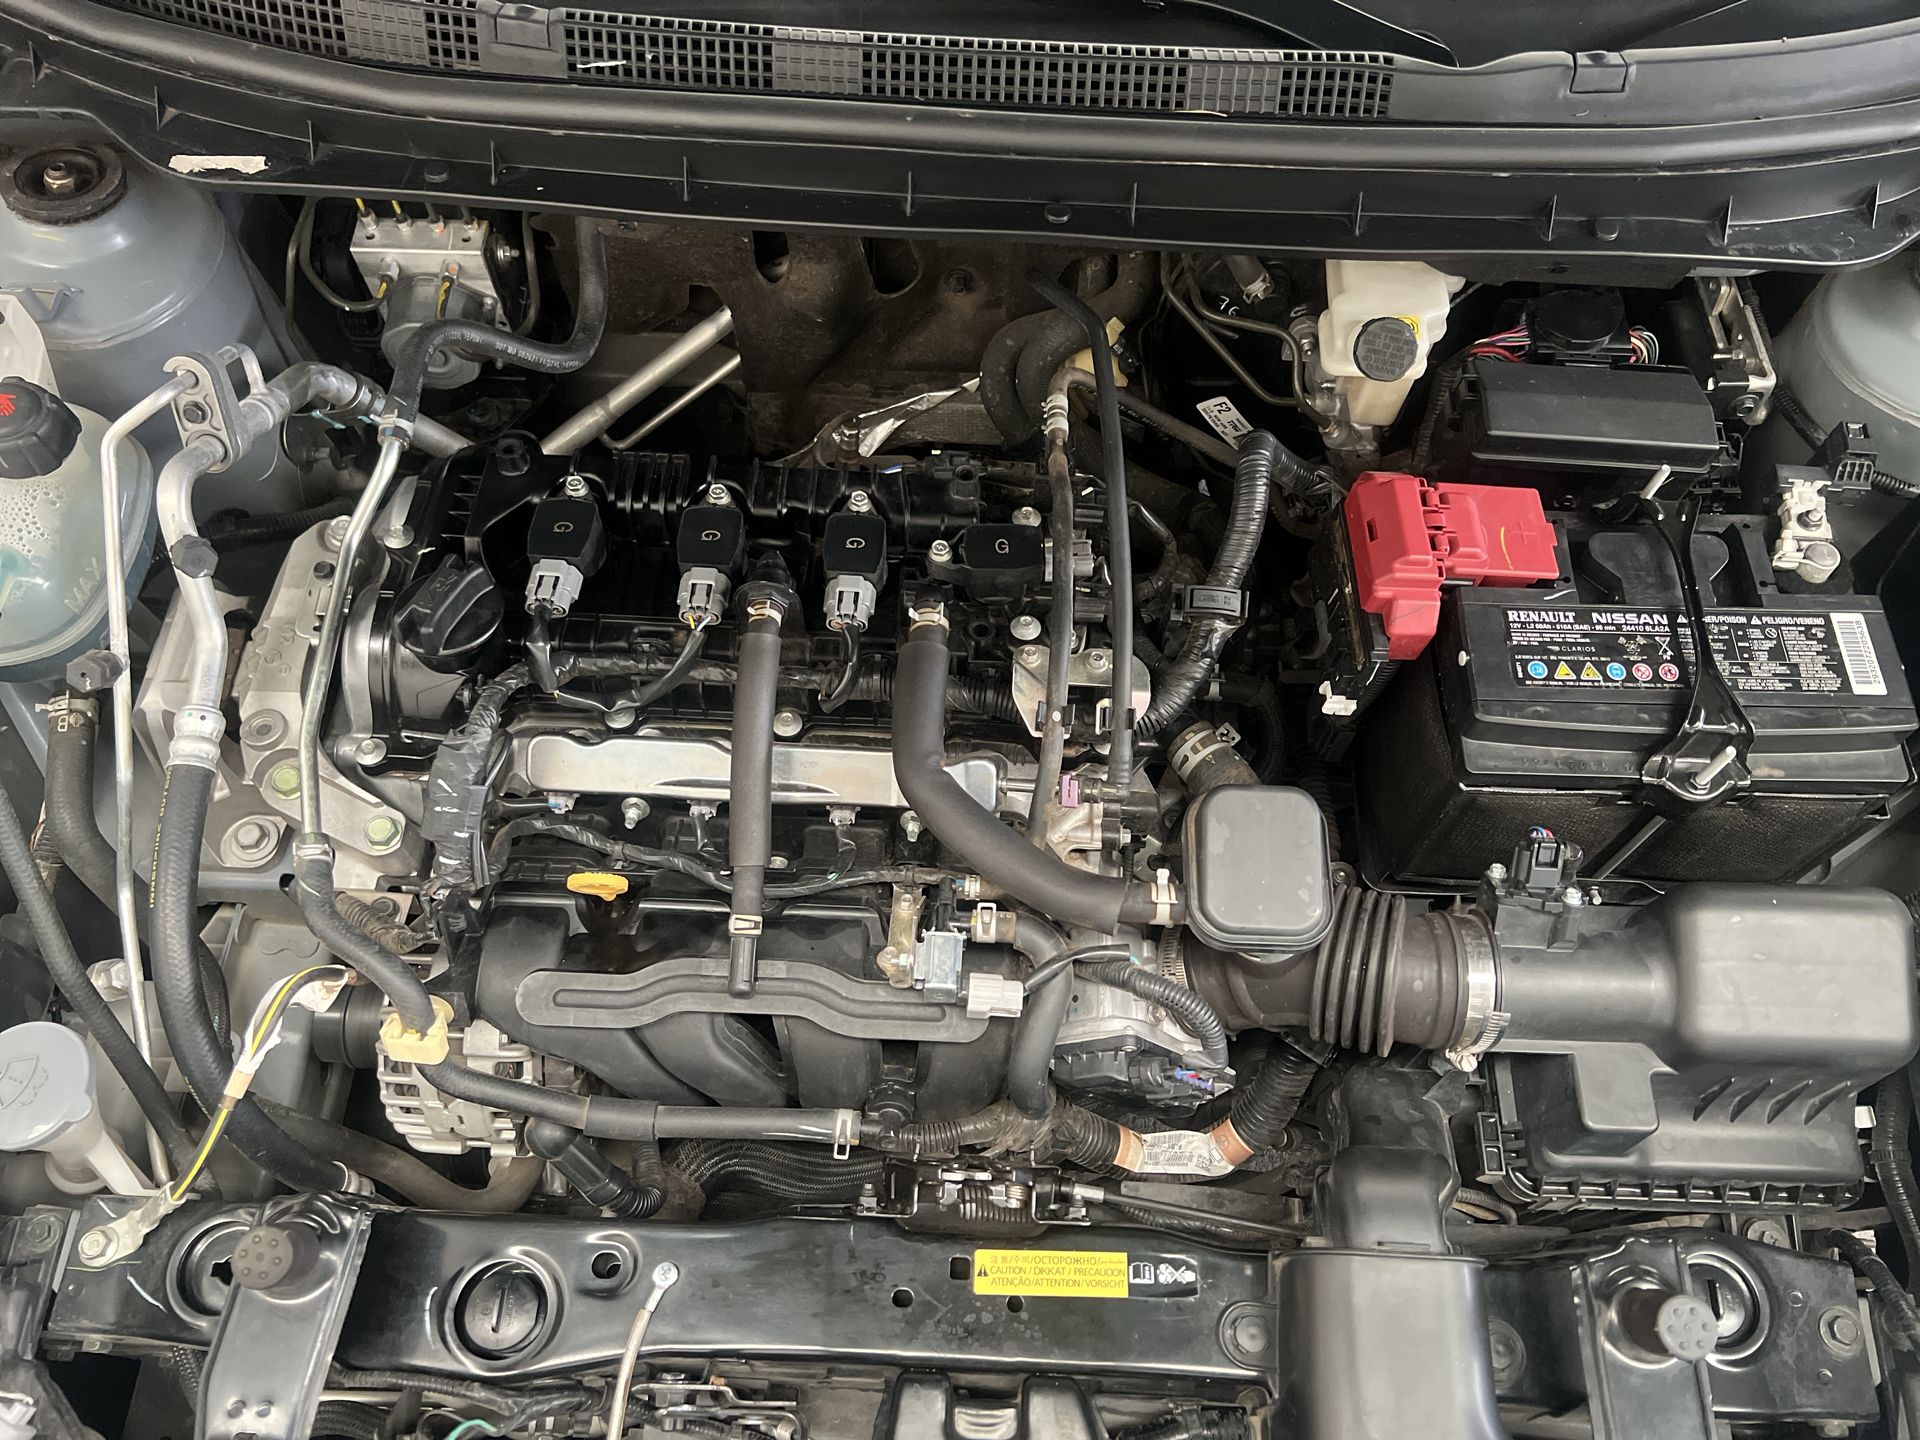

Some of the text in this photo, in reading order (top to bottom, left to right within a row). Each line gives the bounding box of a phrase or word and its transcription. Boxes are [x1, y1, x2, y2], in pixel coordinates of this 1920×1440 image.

[1213, 401, 1232, 414] F2
[995, 538, 1009, 554] G
[1507, 610, 1669, 625] RENAULT NISSAN
[990, 1266, 1026, 1274] CAUTION
[1034, 1266, 1066, 1276] DIKKAT
